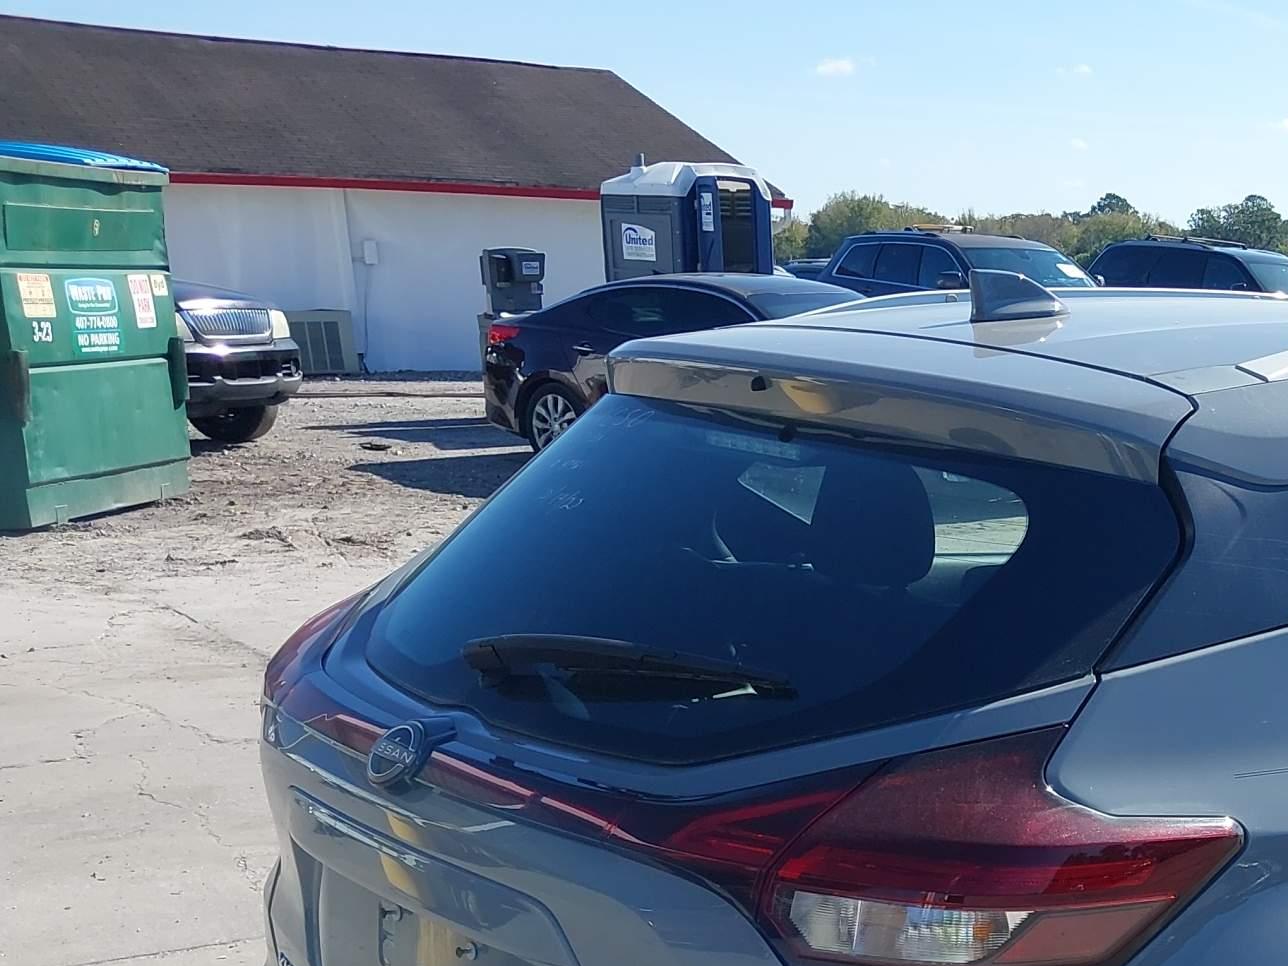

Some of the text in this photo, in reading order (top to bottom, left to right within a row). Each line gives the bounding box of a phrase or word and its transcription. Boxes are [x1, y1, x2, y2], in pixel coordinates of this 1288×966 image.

[625, 233, 654, 246] United
[32, 321, 53, 342] 3-23
[77, 332, 120, 346] NO PARKING
